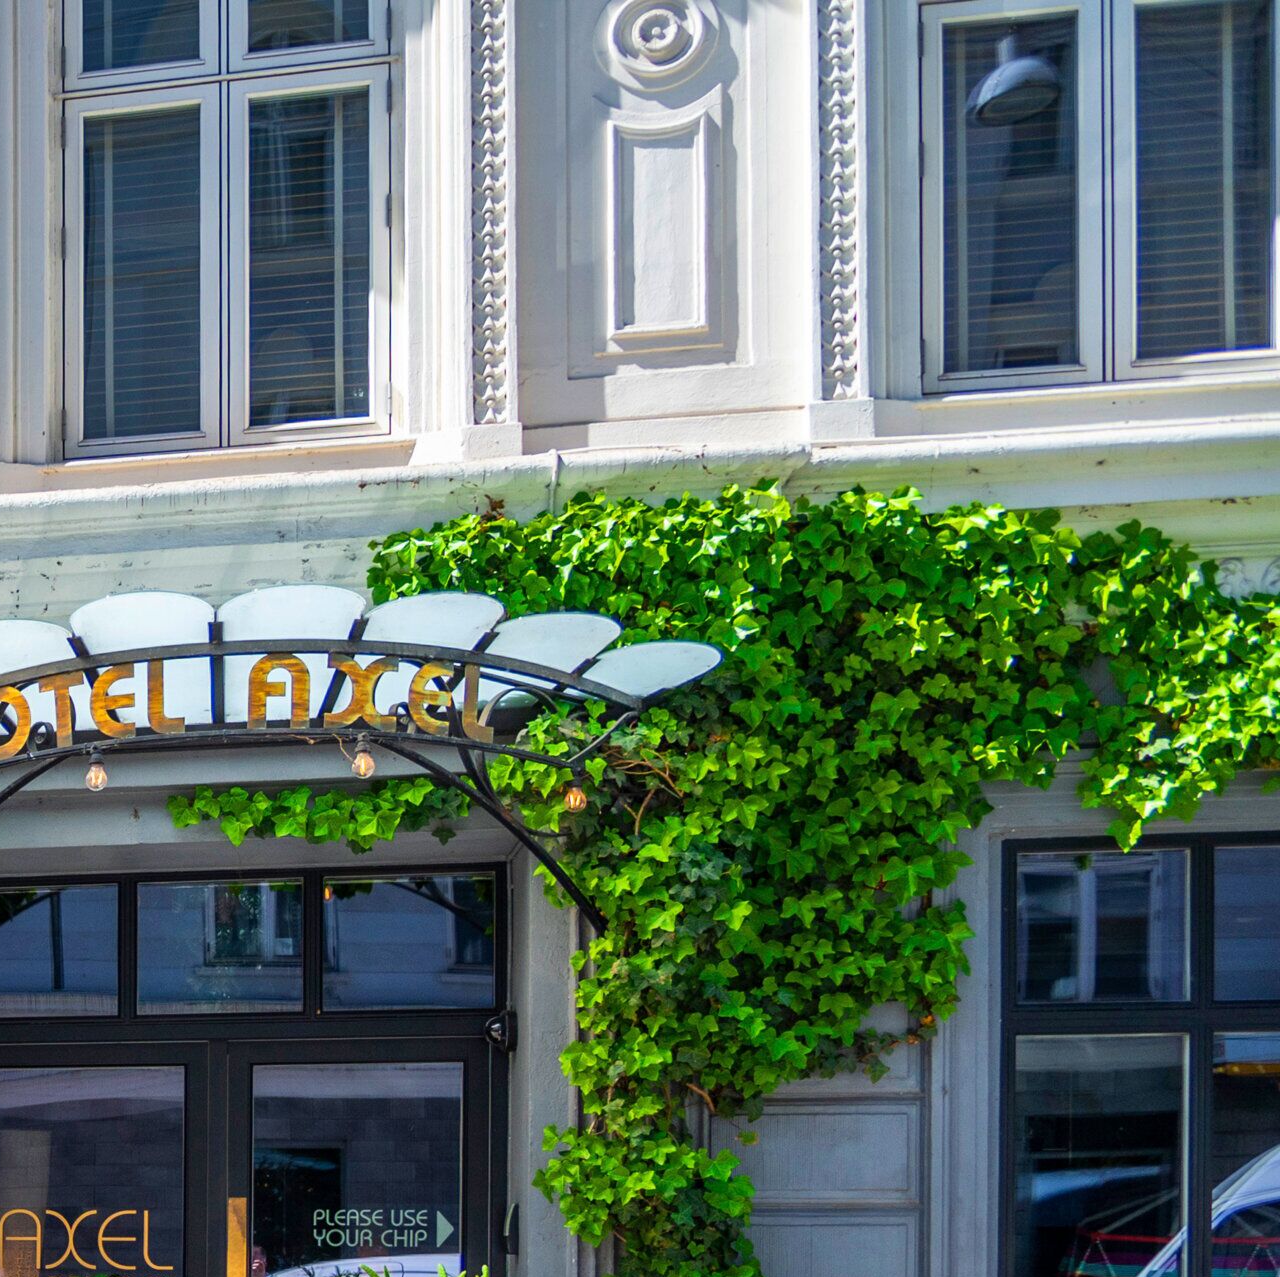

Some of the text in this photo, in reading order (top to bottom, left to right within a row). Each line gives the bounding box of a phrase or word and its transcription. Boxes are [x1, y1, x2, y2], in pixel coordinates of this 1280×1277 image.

[248, 652, 494, 743] AXEL
[313, 1209, 428, 1227] PLEASE USE
[313, 1229, 428, 1247] YOUR CHIP
